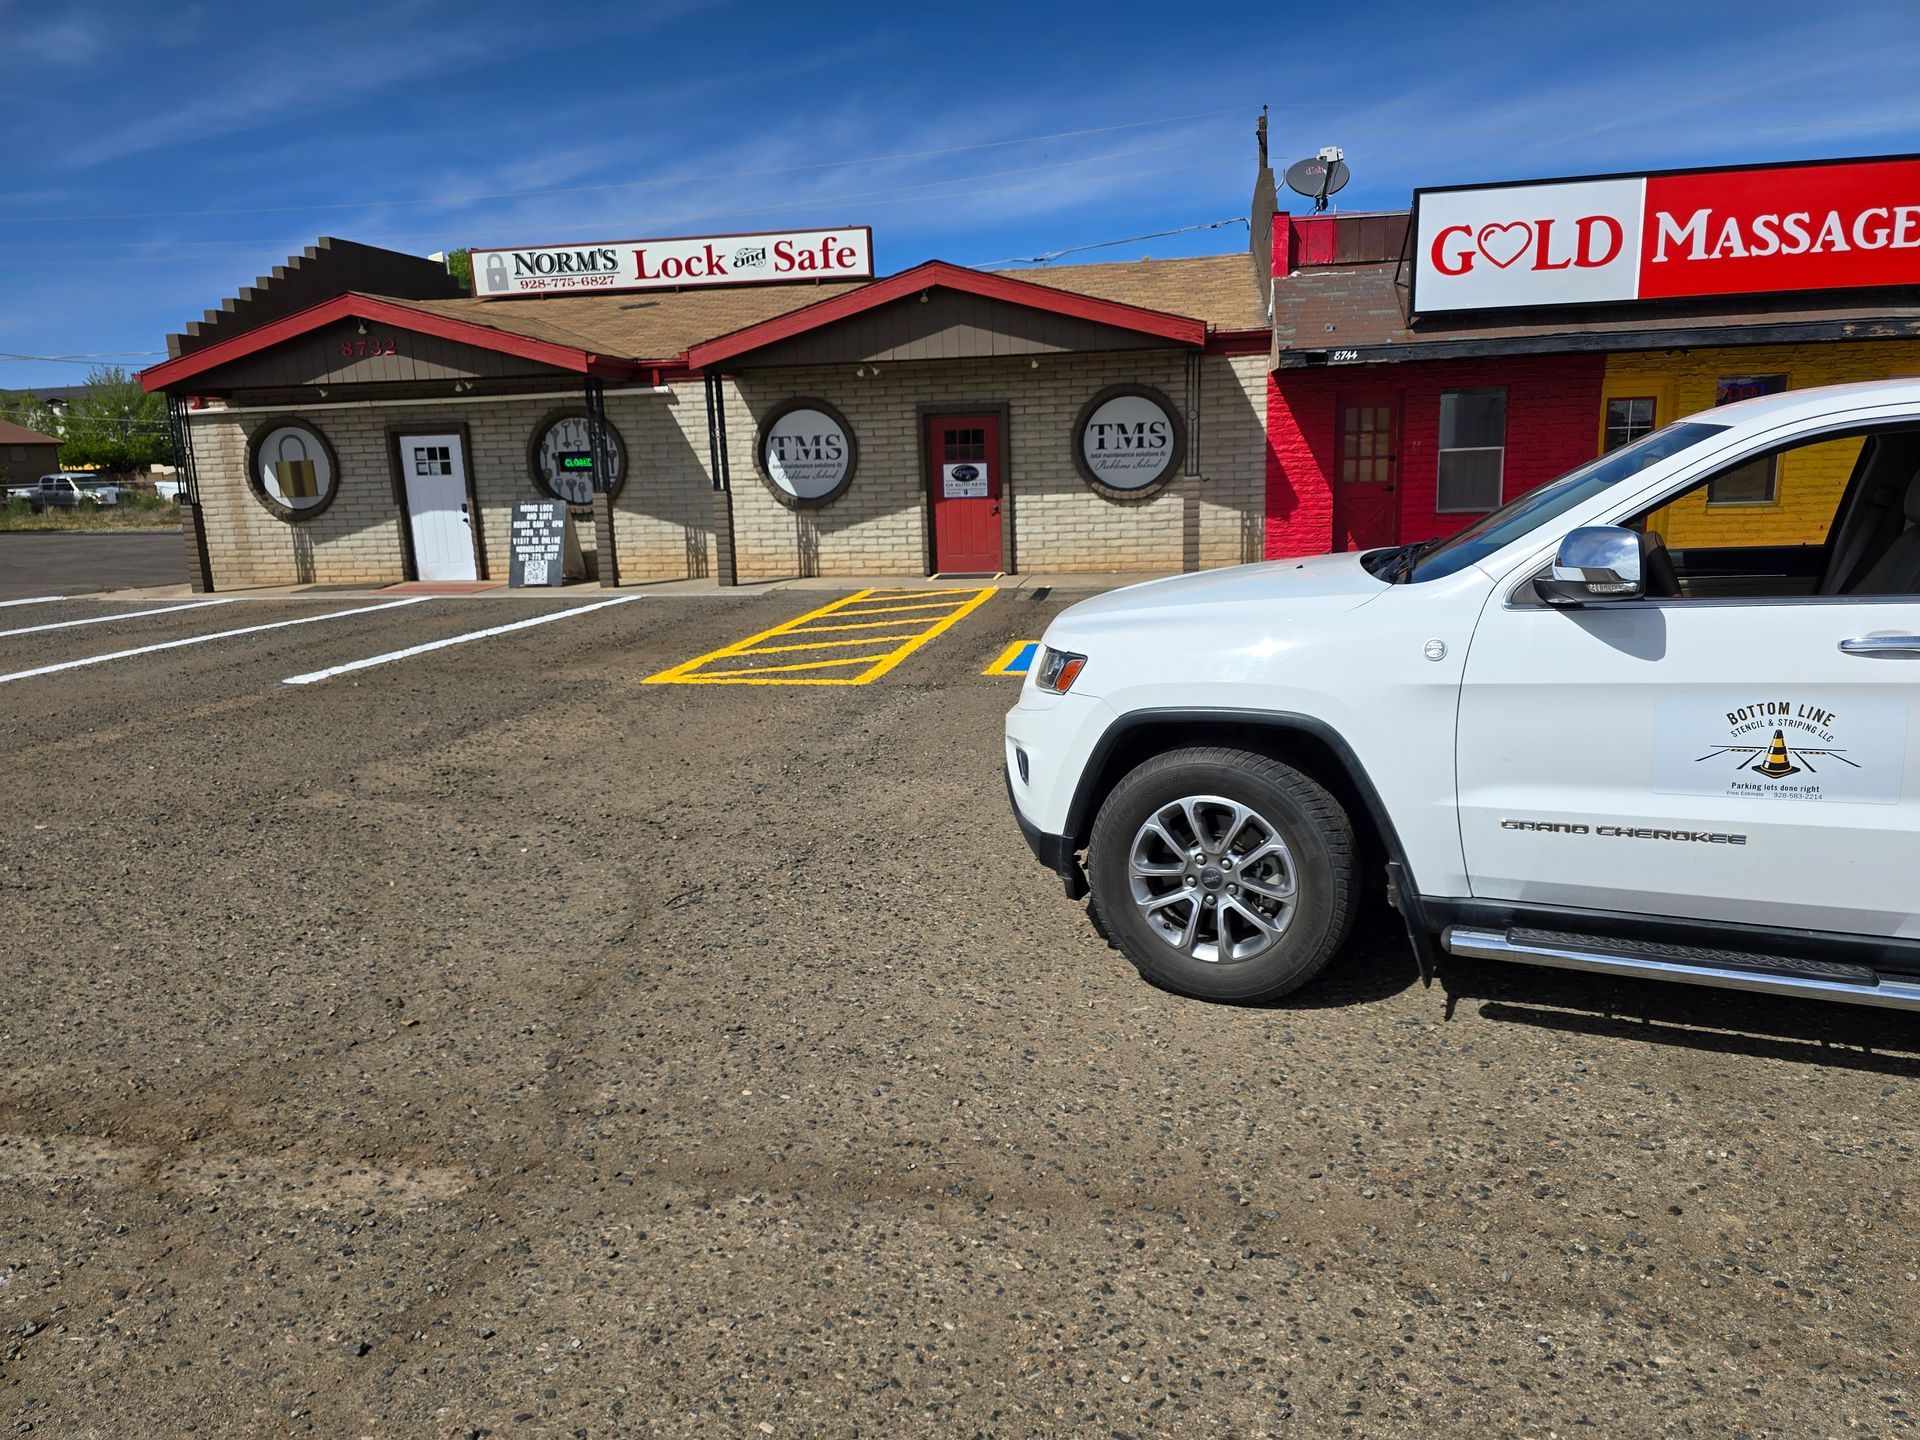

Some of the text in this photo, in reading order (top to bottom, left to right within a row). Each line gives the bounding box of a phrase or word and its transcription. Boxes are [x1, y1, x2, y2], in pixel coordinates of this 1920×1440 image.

[1651, 206, 1920, 264] MASSAGE
[512, 237, 856, 280] NORM'S Lock and Safe
[520, 276, 615, 290] 928-775-6827
[342, 340, 396, 357] 8732
[1334, 350, 1358, 360] 8744
[1090, 421, 1167, 450] TMS
[771, 434, 842, 461] TMS
[539, 504, 554, 512] LOCK
[539, 512, 552, 520] SAFE
[1726, 702, 1836, 727] BOTTOM LINE
[1730, 720, 1765, 738] STENCIL
[1778, 718, 1818, 734] STRIPING
[1818, 729, 1834, 743] LLC
[1731, 782, 1762, 791] Parking
[1780, 784, 1798, 792] done
[1773, 792, 1823, 800] 928-583-2214
[1501, 818, 1747, 845] GRAND CHEROKEE
